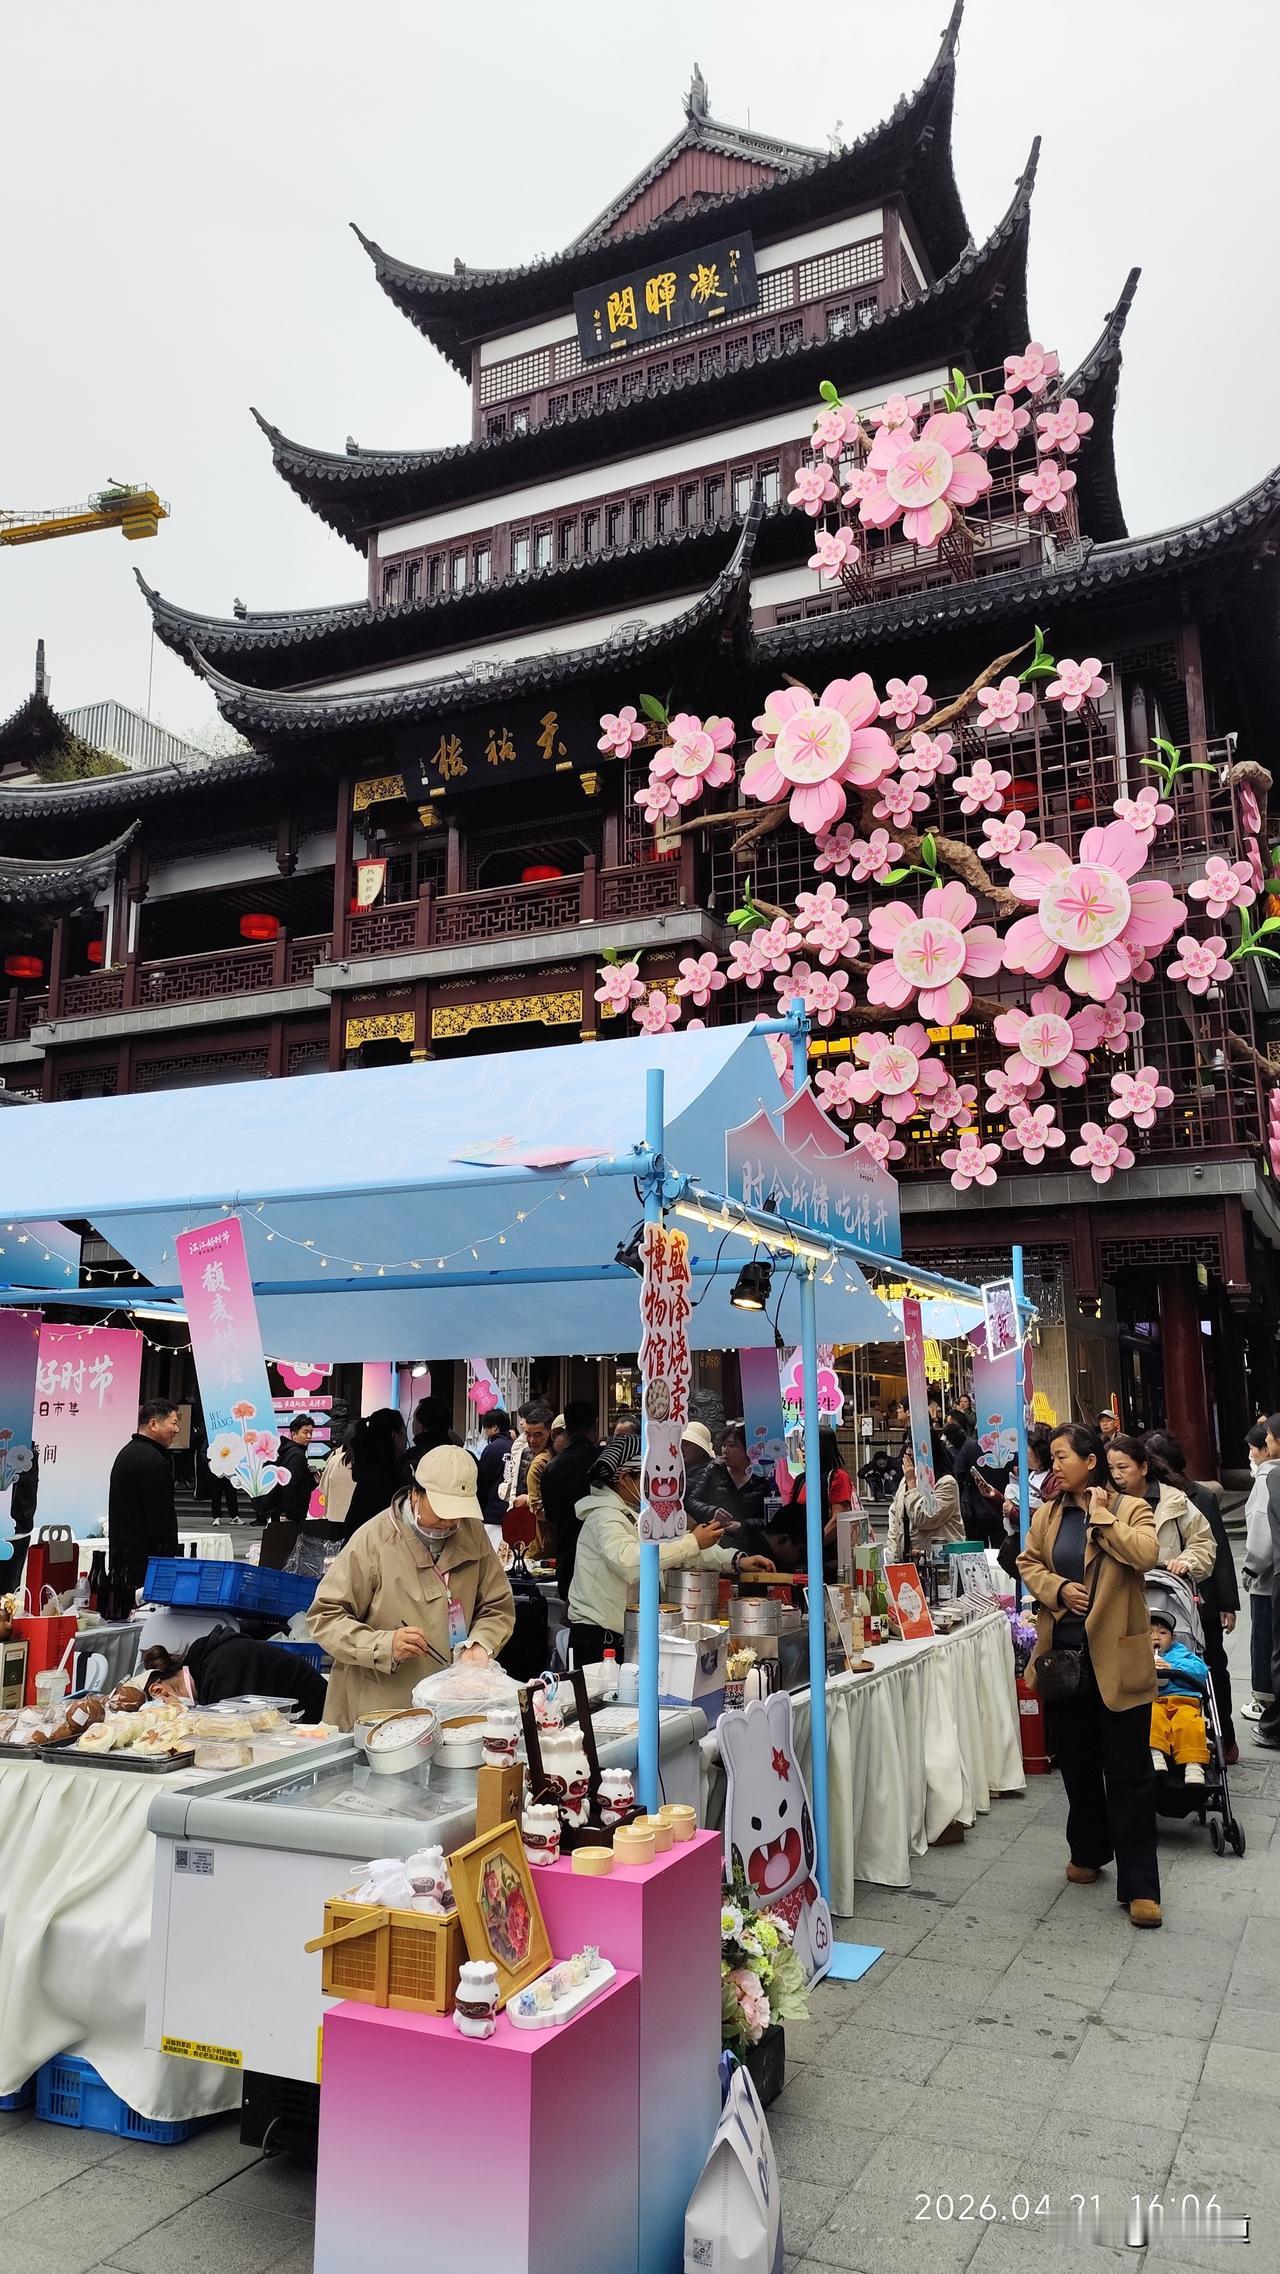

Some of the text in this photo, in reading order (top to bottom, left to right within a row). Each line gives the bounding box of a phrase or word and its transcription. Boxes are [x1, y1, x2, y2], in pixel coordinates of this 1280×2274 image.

[644, 1229, 668, 1381] 博物馆
[667, 1236, 690, 1426] 盛泽烧卖
